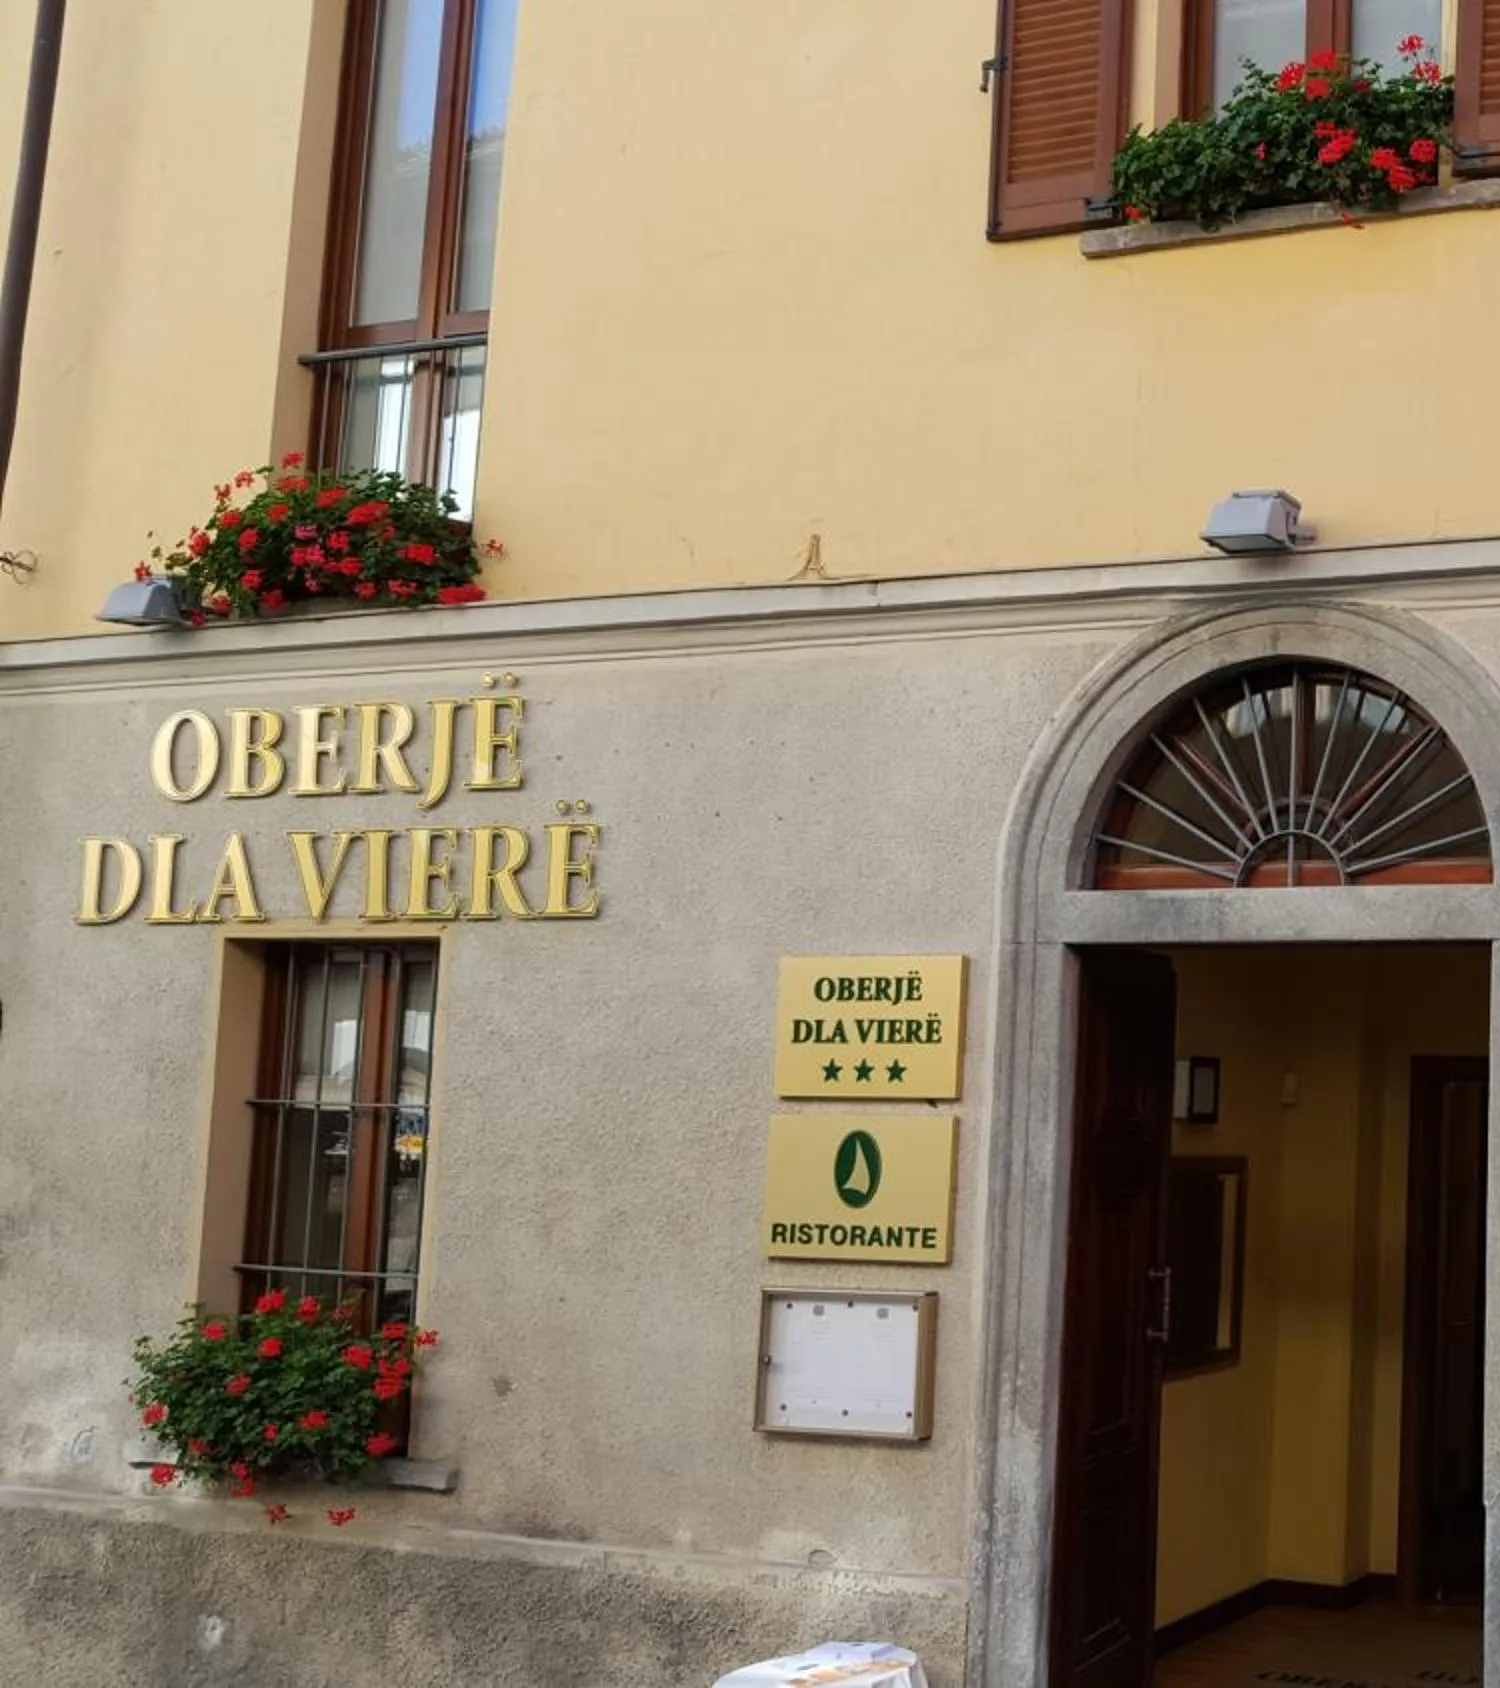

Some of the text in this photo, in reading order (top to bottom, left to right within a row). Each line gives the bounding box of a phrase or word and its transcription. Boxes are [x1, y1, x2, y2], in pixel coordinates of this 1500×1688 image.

[150, 672, 524, 809] OBERJË
[75, 800, 601, 924] DLA VIERË
[814, 971, 923, 1005] OBERJË
[791, 1013, 942, 1044] DLA VIERË
[771, 1223, 937, 1248] RISTORANTE
